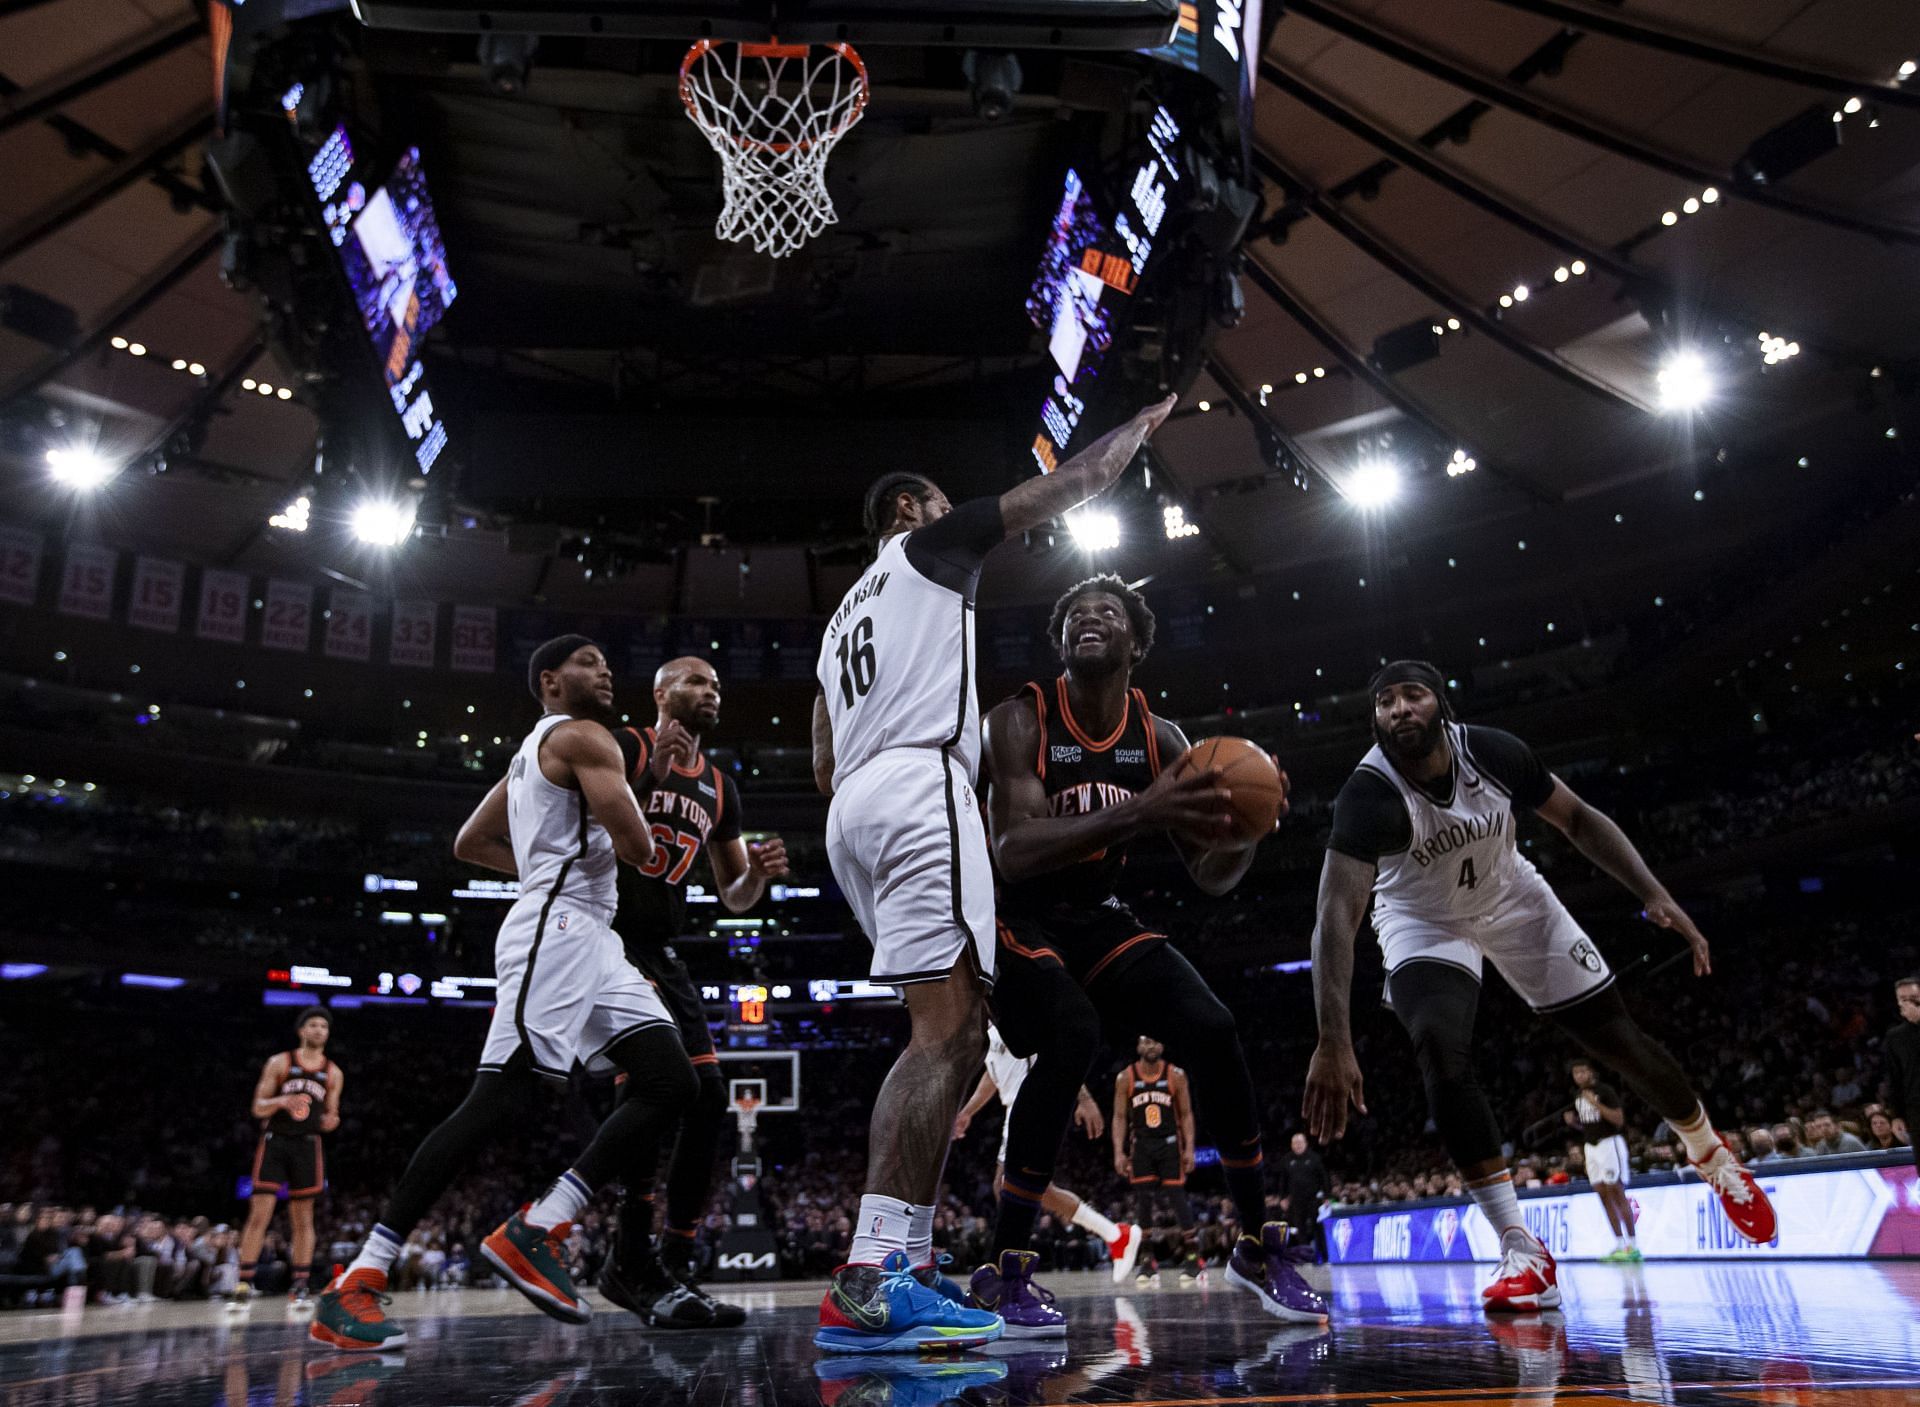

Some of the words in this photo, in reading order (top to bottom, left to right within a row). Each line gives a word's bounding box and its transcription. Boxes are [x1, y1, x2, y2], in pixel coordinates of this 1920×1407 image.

[141, 576, 175, 608] 15
[208, 590, 241, 619] 19
[831, 572, 891, 639] JOHNSON
[270, 600, 307, 629] 22
[836, 616, 876, 711] 16
[1114, 749, 1145, 757] SQUARE
[680, 795, 713, 845] YORK
[1412, 811, 1504, 868] BROOKLYN
[637, 822, 700, 885] 67
[1457, 856, 1478, 890] 4
